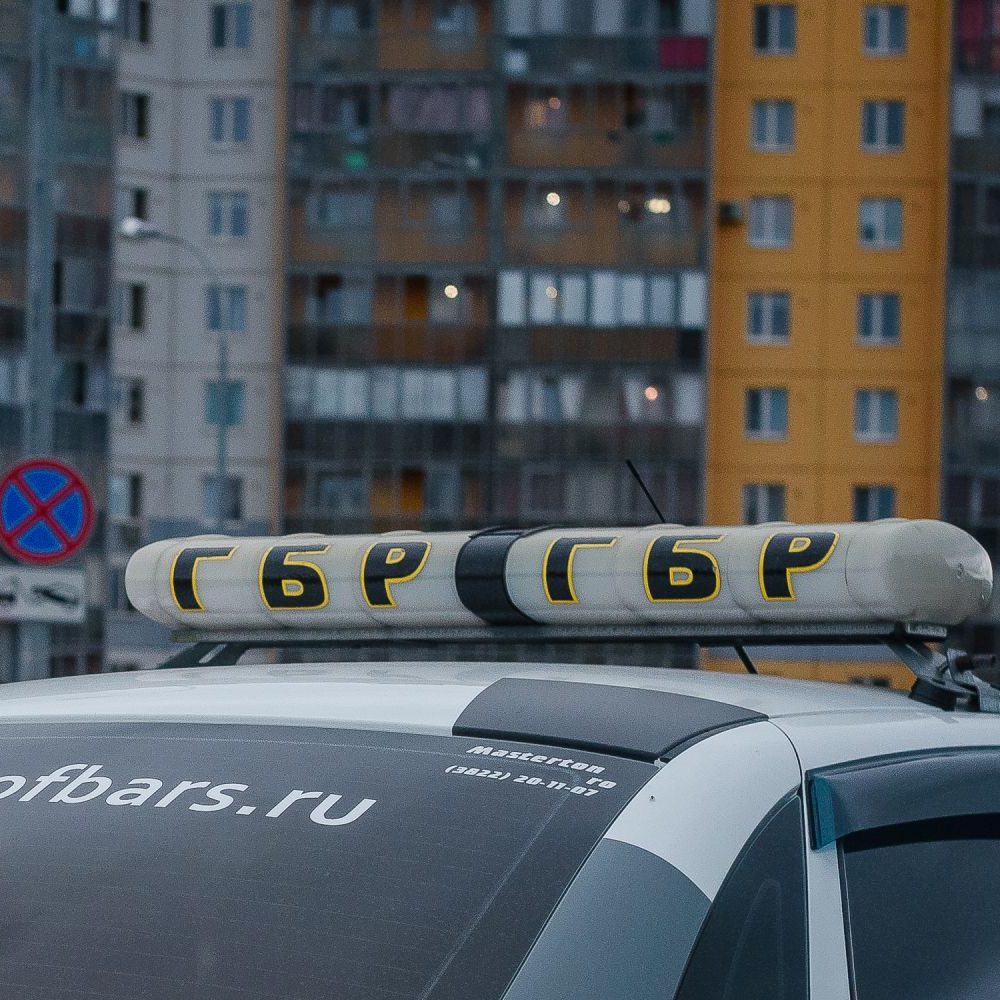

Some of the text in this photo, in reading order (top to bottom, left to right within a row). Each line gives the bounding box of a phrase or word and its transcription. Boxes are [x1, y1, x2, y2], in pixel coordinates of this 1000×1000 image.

[170, 531, 840, 612] ГБР ГБР
[465, 745, 606, 774] Masterton
[444, 765, 600, 797] (3822) 20-11-07
